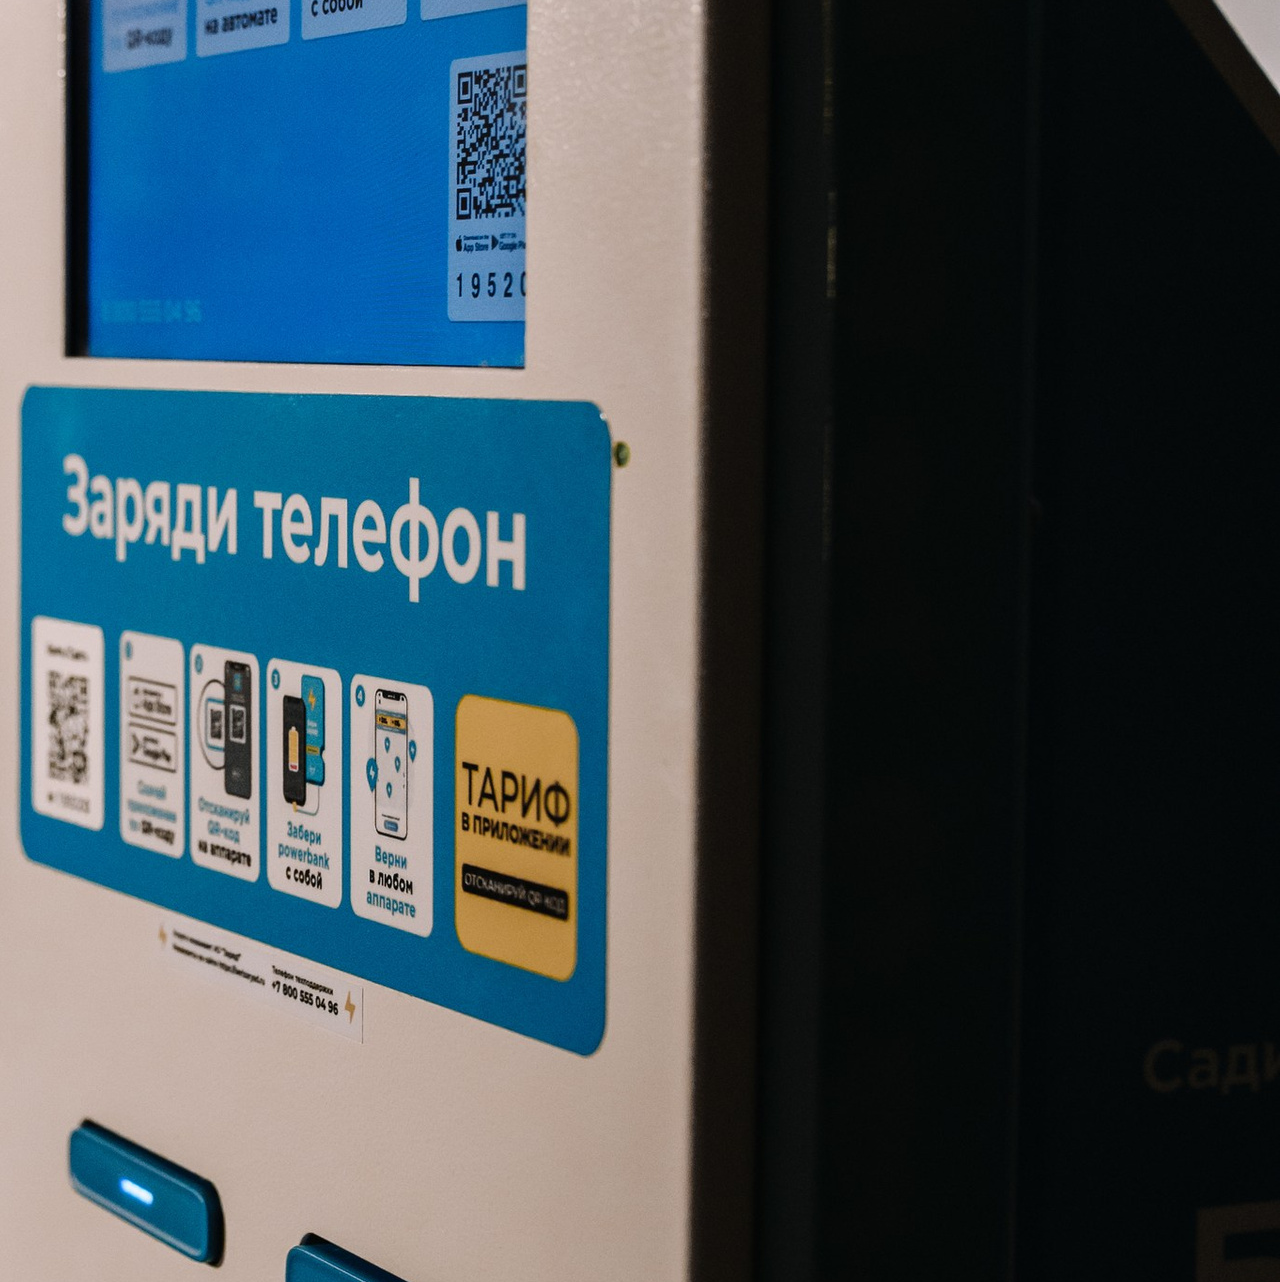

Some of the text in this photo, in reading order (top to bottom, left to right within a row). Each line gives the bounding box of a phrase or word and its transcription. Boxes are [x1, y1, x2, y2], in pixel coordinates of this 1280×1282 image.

[222, 6, 279, 34] автомате
[311, 0, 319, 17] с
[62, 454, 527, 602] Заряди телефон
[462, 762, 571, 827] ТАРИФ
[286, 822, 322, 845] Забери
[462, 812, 571, 857] В ПРИЛОЖЕНИИ
[198, 839, 251, 867] на аппарате
[278, 842, 330, 871] powerbank
[375, 845, 408, 869] Верни
[286, 867, 323, 890] с собой
[369, 869, 413, 895] в любом
[464, 873, 526, 900] ОТСКАНИРУЙ
[366, 891, 416, 917] аппарате
[272, 980, 339, 1016] +7 800 555 04 96
